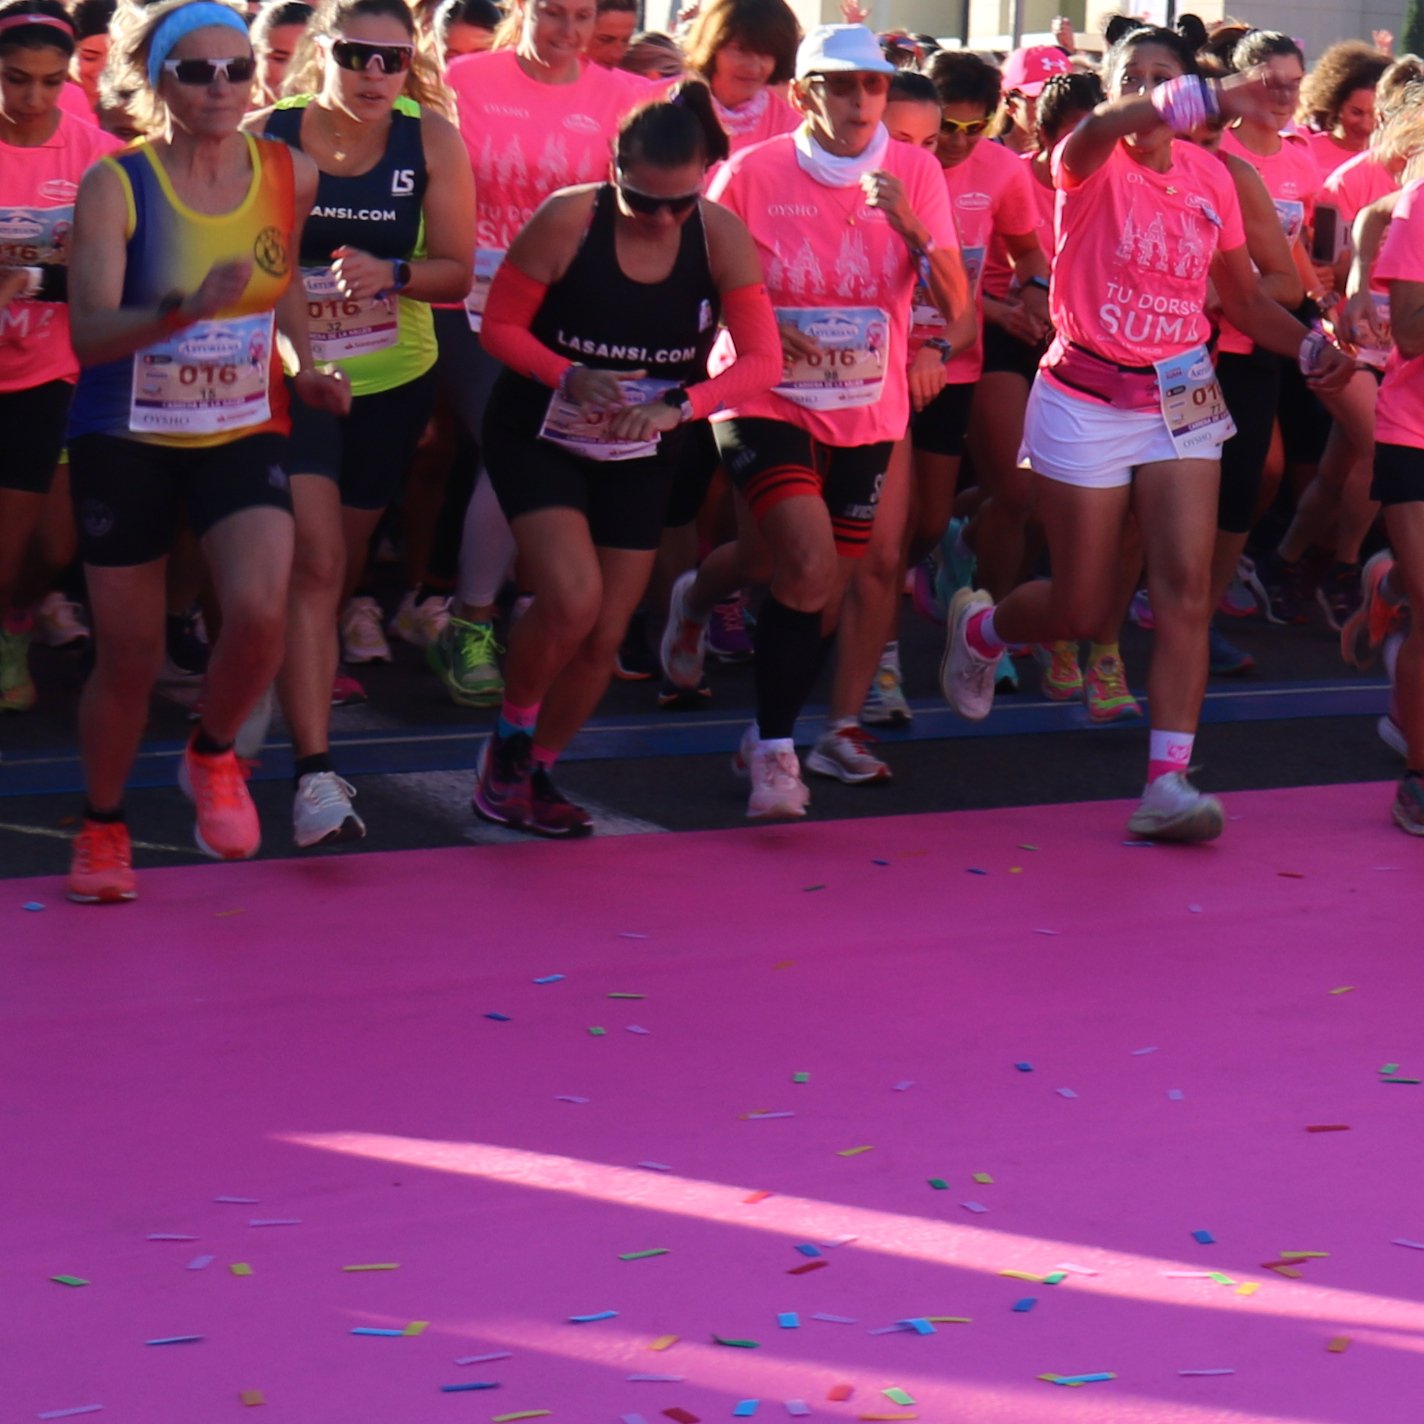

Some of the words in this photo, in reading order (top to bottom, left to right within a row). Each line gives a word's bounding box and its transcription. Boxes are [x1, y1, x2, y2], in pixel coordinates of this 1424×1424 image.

[391, 169, 415, 193] LS
[310, 206, 396, 221] ANSI.COM
[1106, 282, 1132, 304] TU
[308, 301, 359, 319] 016
[1100, 303, 1200, 343] SUMA
[557, 329, 696, 364] LASANSI.COM
[179, 365, 238, 385] 016
[1192, 382, 1219, 405] 01
